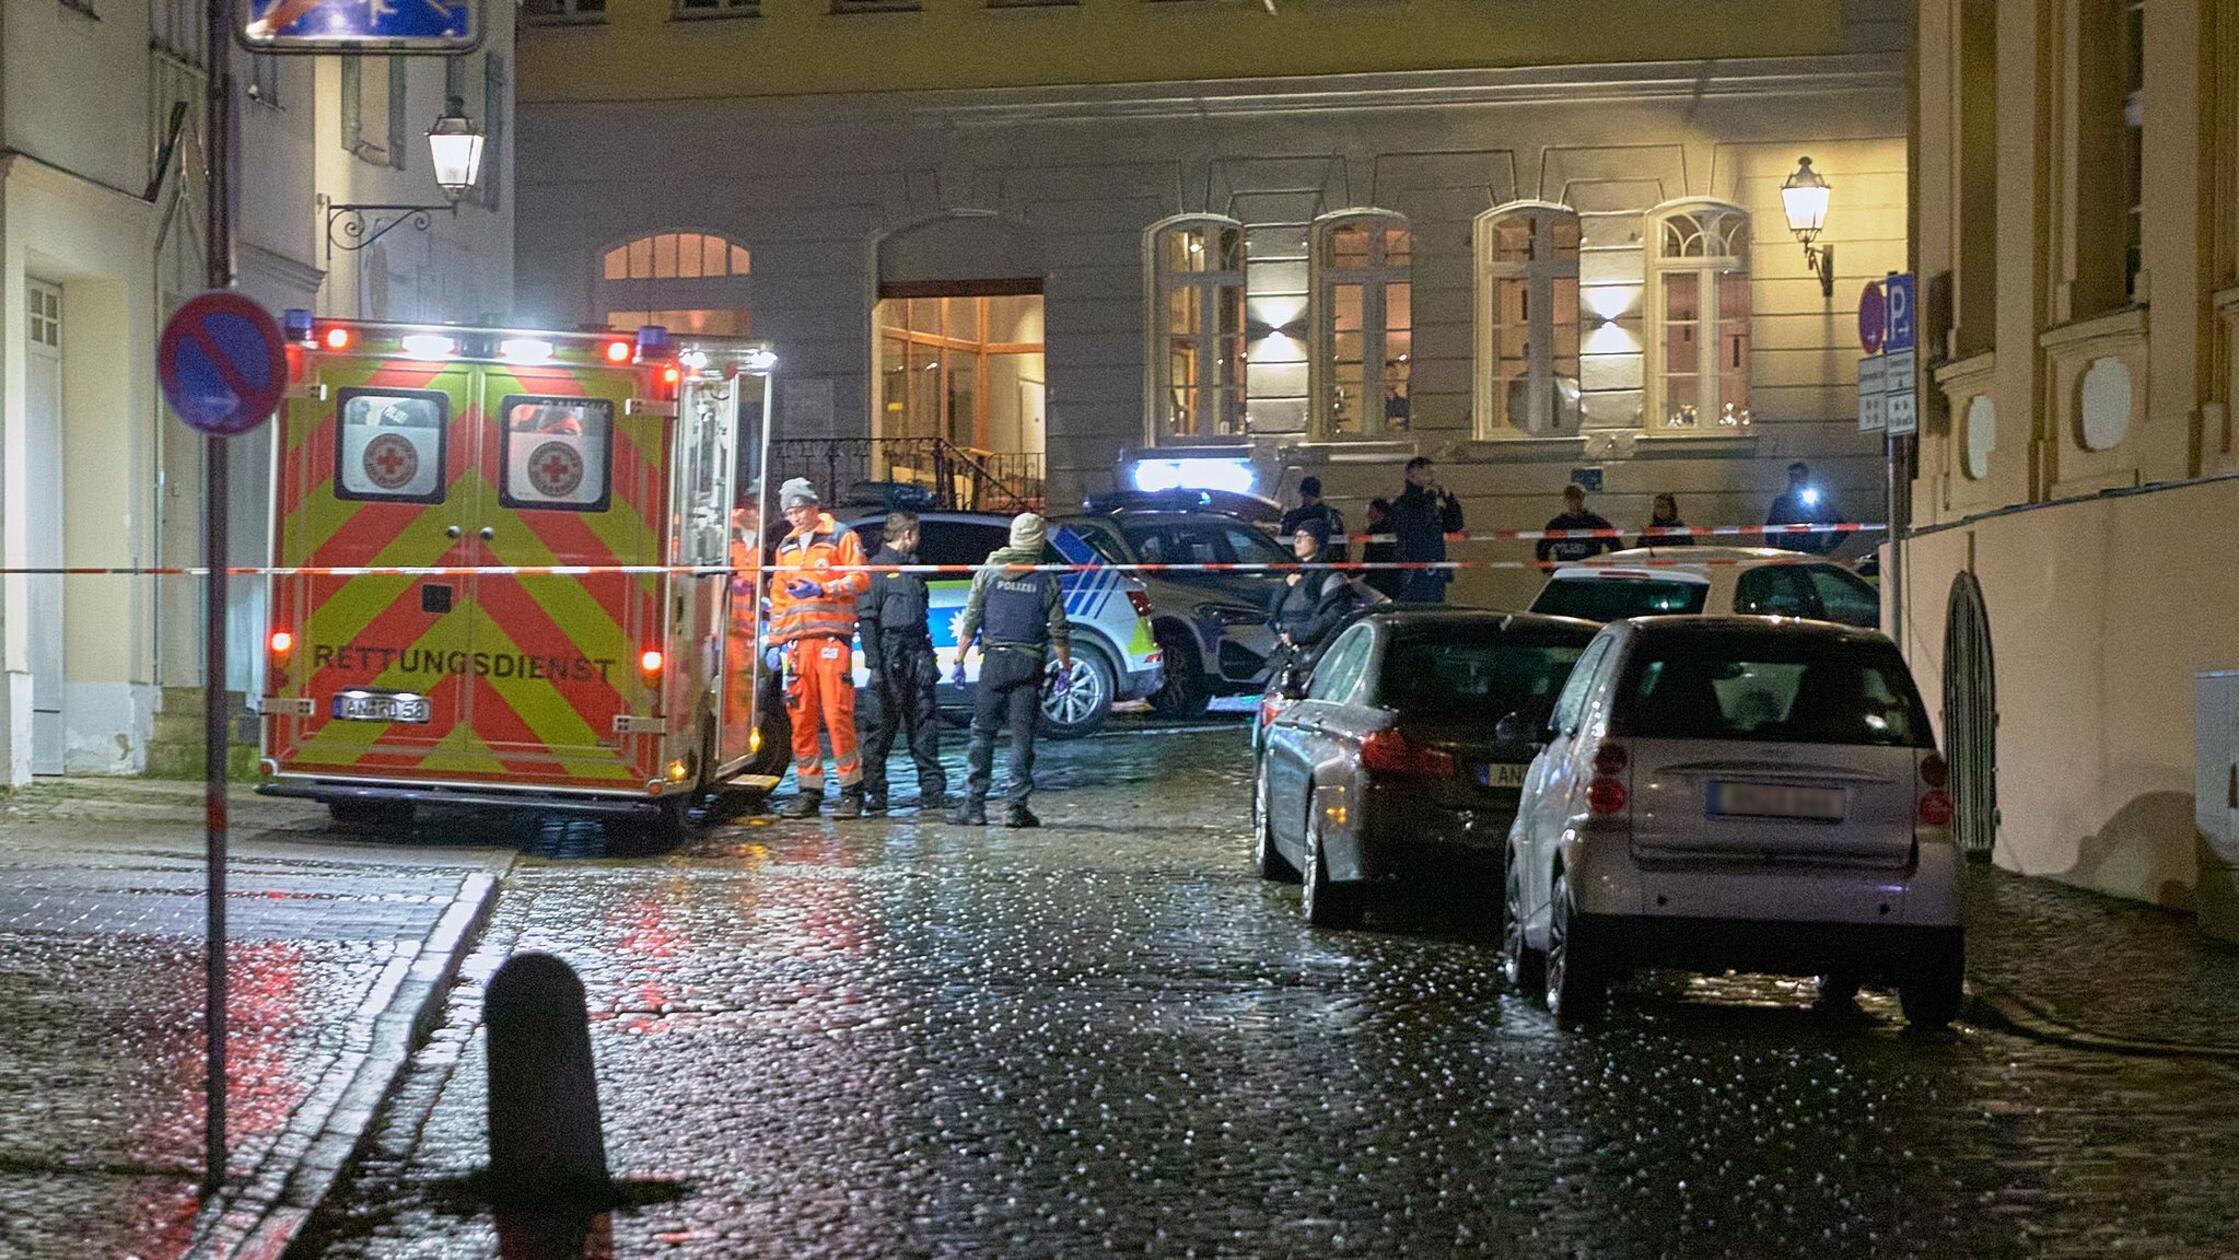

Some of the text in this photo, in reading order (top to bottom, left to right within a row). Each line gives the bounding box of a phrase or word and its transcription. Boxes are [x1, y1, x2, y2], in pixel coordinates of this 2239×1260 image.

[1891, 285, 1905, 341] P
[996, 580, 1037, 592] POLIZEI
[314, 644, 616, 683] RETTUNGSDIENST
